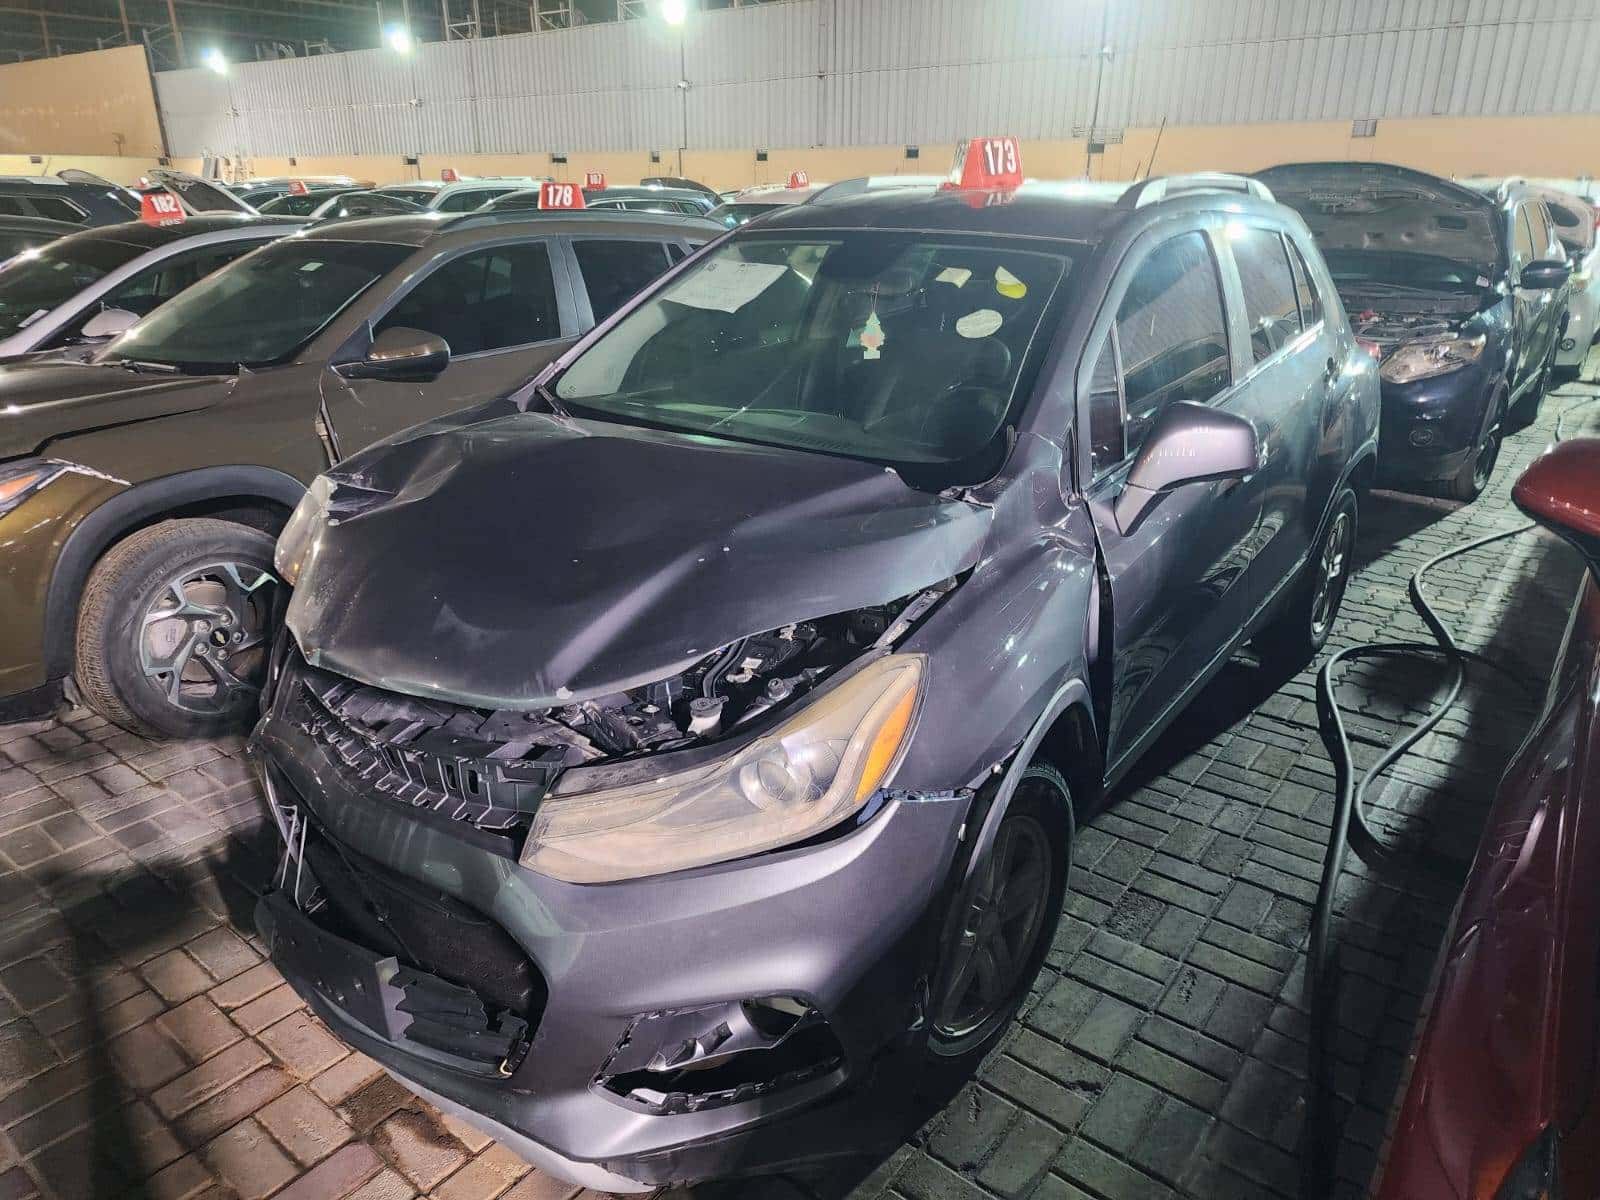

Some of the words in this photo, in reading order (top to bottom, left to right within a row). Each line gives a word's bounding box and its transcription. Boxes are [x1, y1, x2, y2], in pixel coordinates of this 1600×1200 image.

[985, 140, 1017, 176] 173
[150, 194, 179, 214] 182
[547, 184, 573, 207] 178
